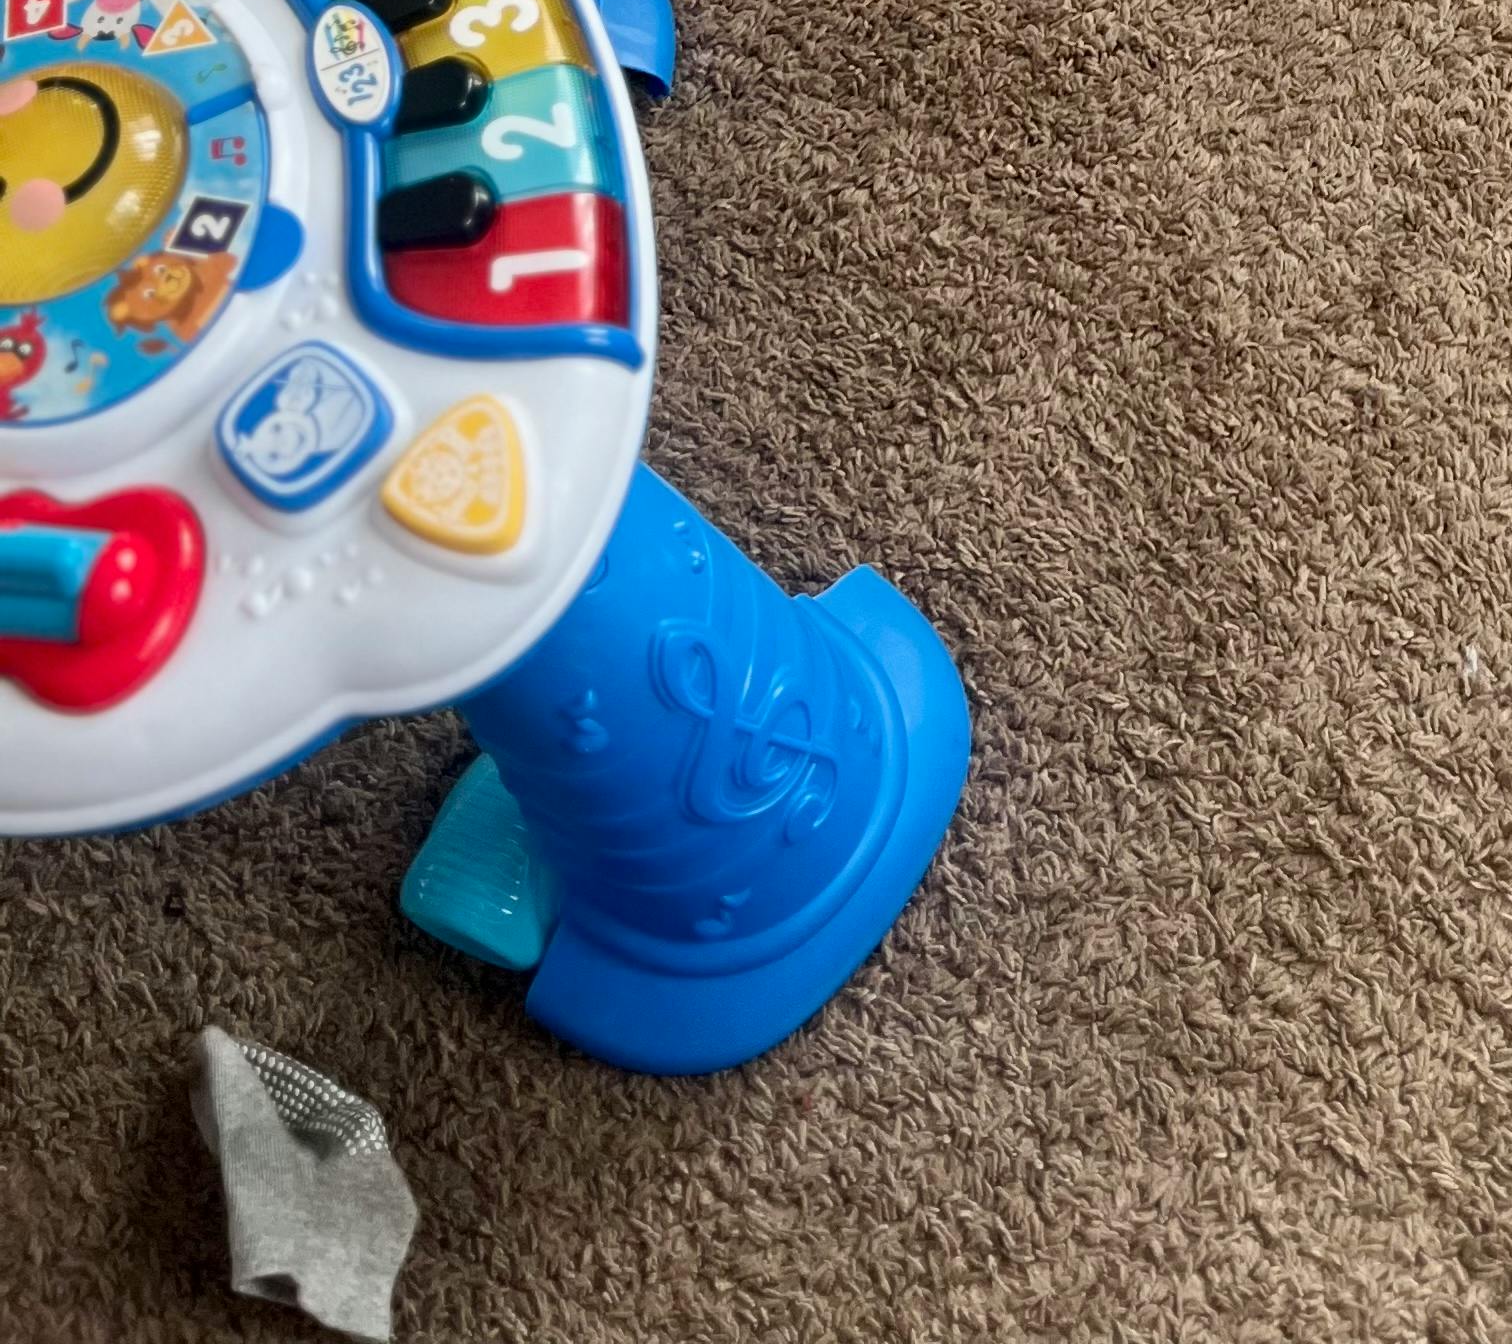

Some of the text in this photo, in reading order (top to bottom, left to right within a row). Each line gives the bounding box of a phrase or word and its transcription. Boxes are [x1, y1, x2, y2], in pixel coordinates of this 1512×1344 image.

[338, 63, 377, 106] 123
[481, 102, 577, 161] 2
[191, 208, 232, 240] 2
[490, 247, 590, 293] 1
